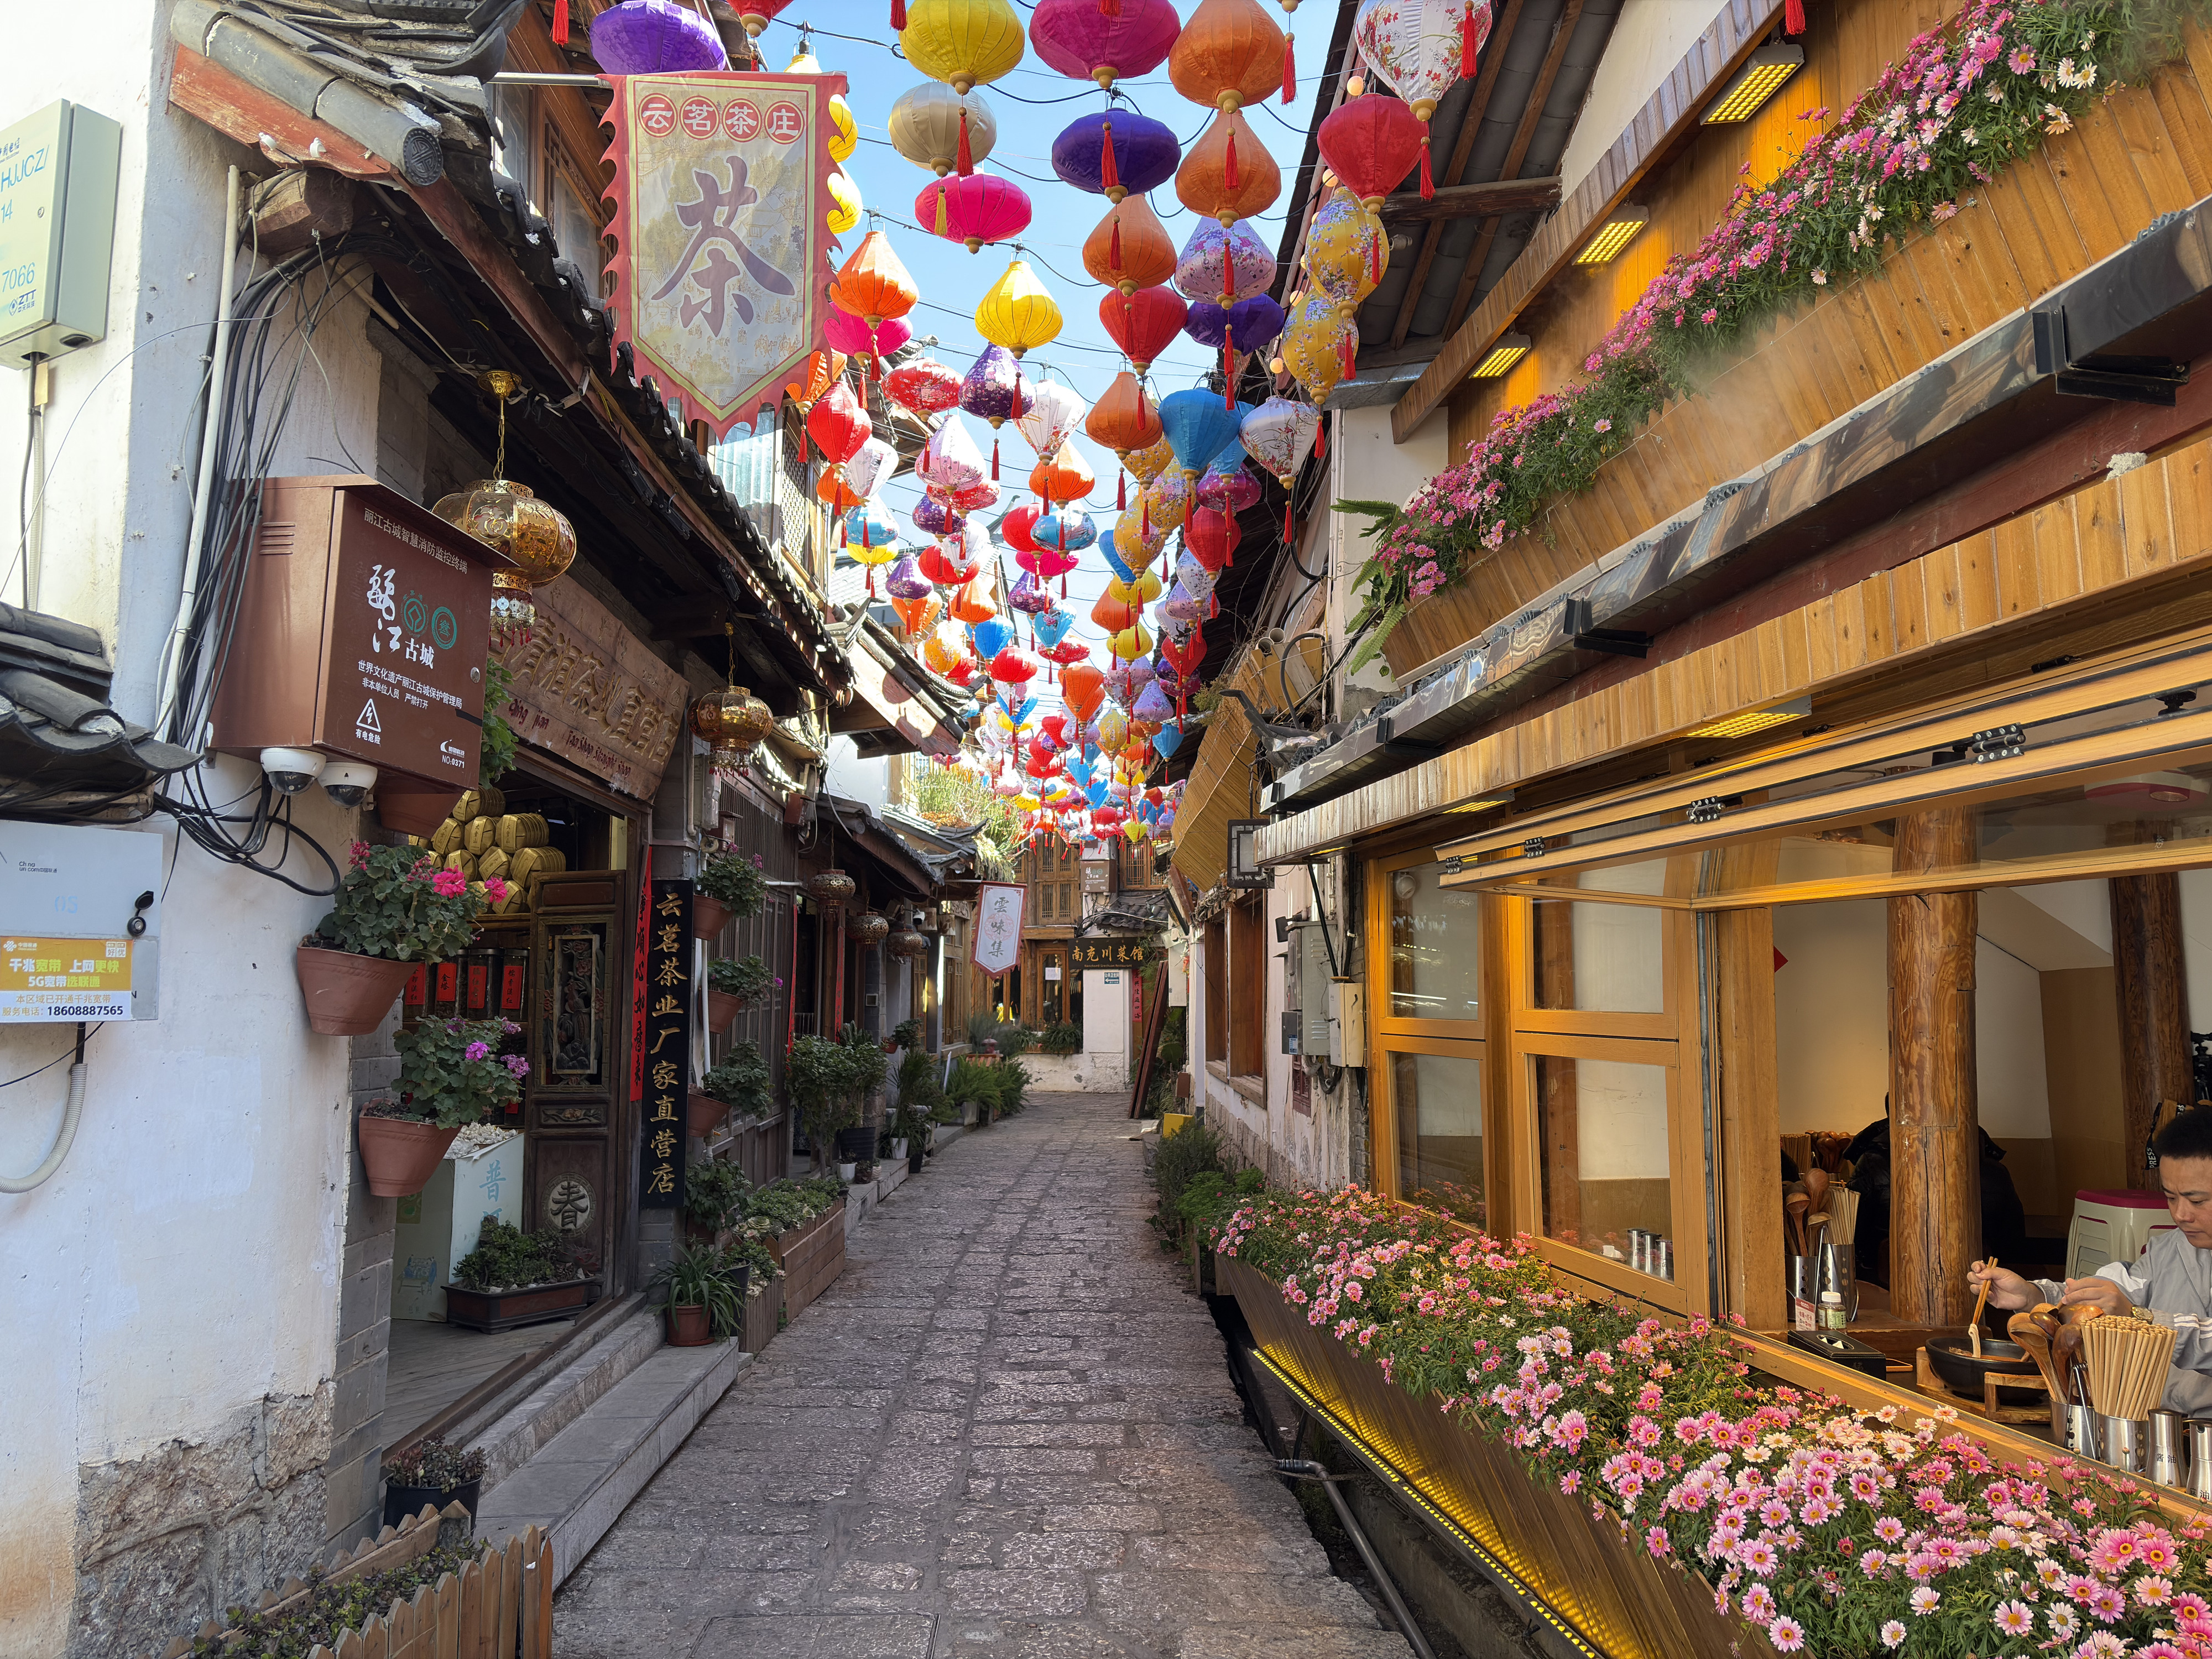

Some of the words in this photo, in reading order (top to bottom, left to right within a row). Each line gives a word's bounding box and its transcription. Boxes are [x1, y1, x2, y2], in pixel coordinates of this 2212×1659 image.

[642, 103, 799, 137] 云茗茶庄
[651, 156, 795, 337] 茶
[2, 262, 35, 292] 7066
[18, 289, 36, 305] ZTT
[364, 508, 467, 574] 丽江古城智慧消防监控终端
[405, 638, 434, 669] 古城
[358, 660, 462, 709] 世界文化遗产丽江古城保护管理局
[362, 677, 399, 699] 非本单位人员
[404, 693, 428, 709] 严禁打开
[356, 728, 380, 744] 有电危险
[442, 754, 465, 769] NO:0371
[988, 896, 1009, 958] 雲味集
[9, 958, 61, 972] 千兆宽带
[69, 959, 119, 973] 上网更快
[1072, 945, 1145, 963] 南充川菜馆
[28, 976, 100, 988] 5G宽带选联通
[16, 994, 111, 1004] 本区域已开通千兆宽带
[48, 1005, 124, 1016] 18608887565
[648, 892, 688, 1195] 云茗茶业厂家直营店
